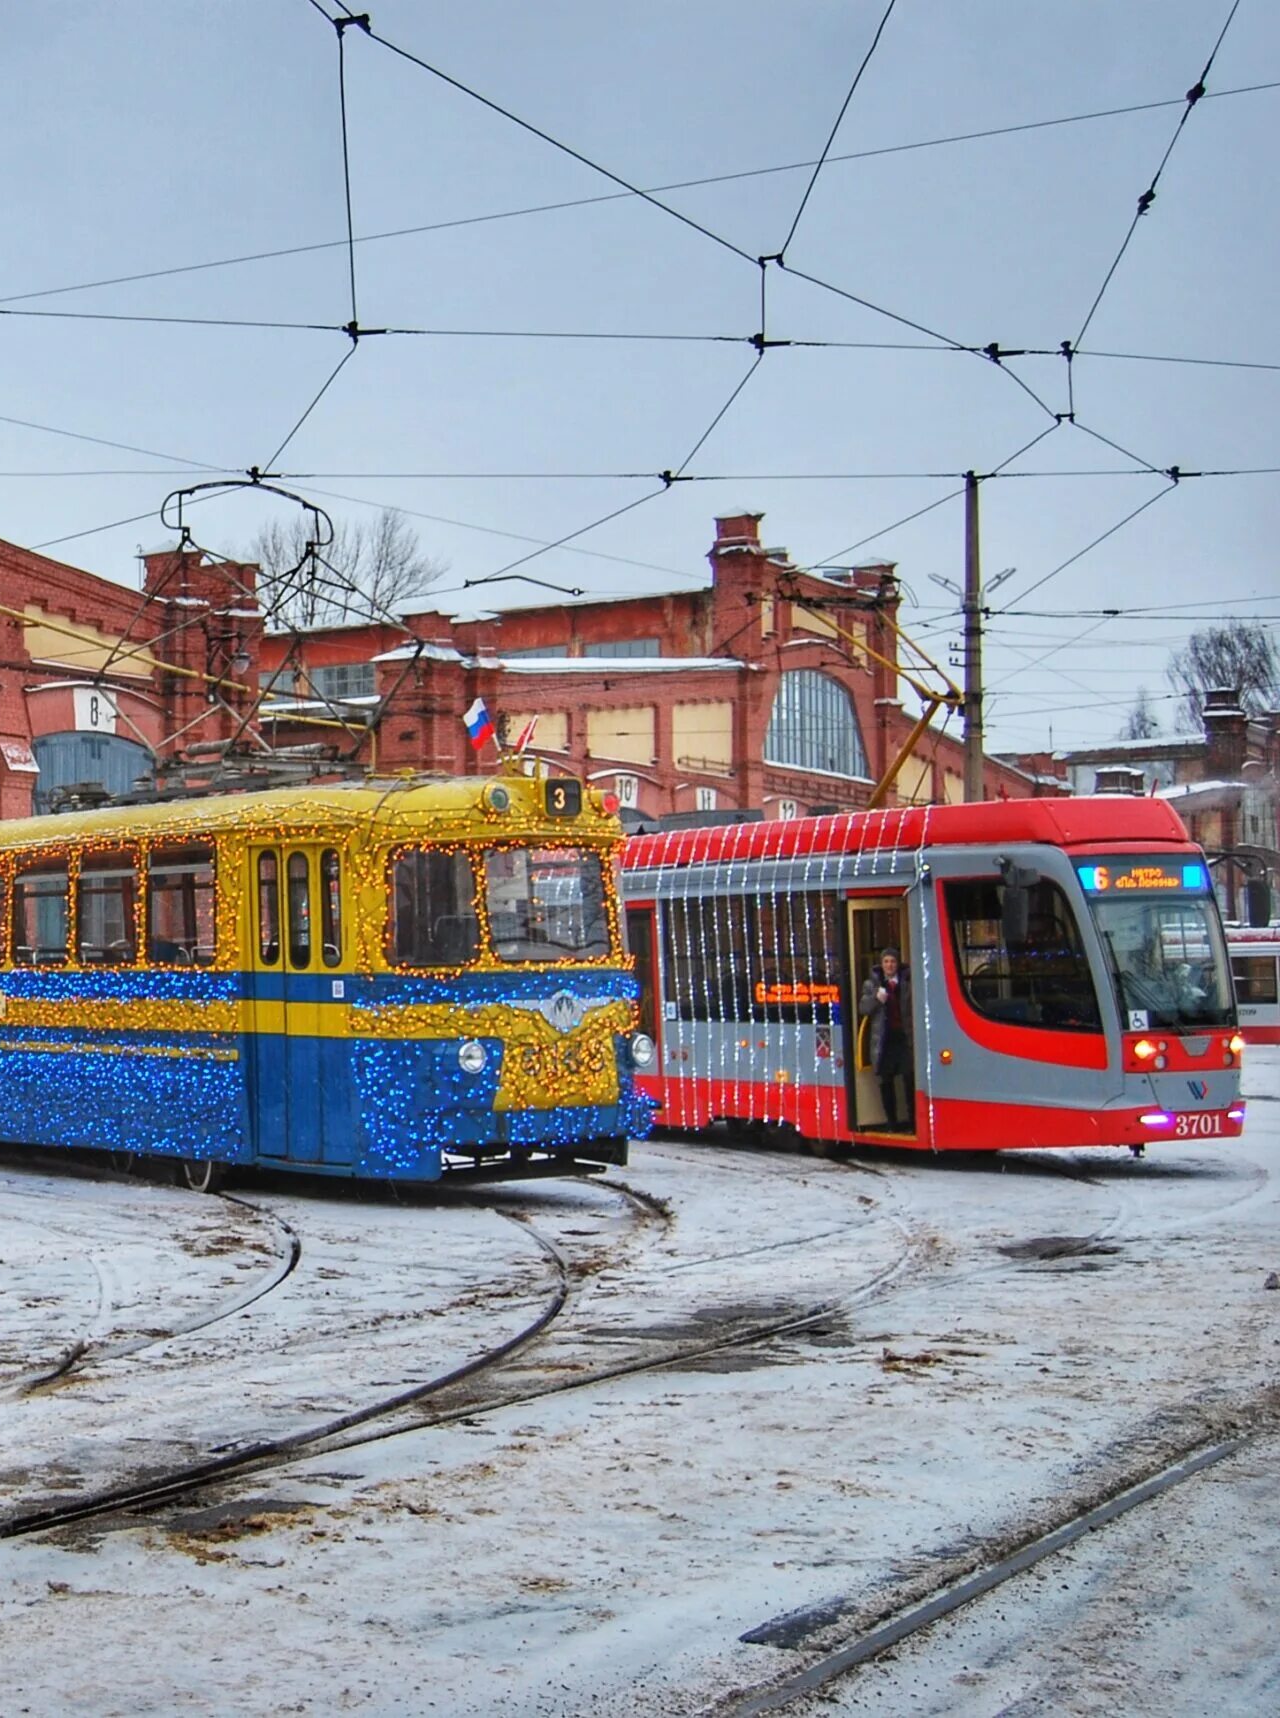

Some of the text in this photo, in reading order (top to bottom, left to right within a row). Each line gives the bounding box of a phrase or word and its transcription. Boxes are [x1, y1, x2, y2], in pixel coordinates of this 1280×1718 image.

[90, 695, 99, 727] 8
[553, 787, 566, 810] 3
[618, 777, 633, 802] 10
[1093, 866, 1110, 890] 6
[1176, 1114, 1223, 1136] 3701
